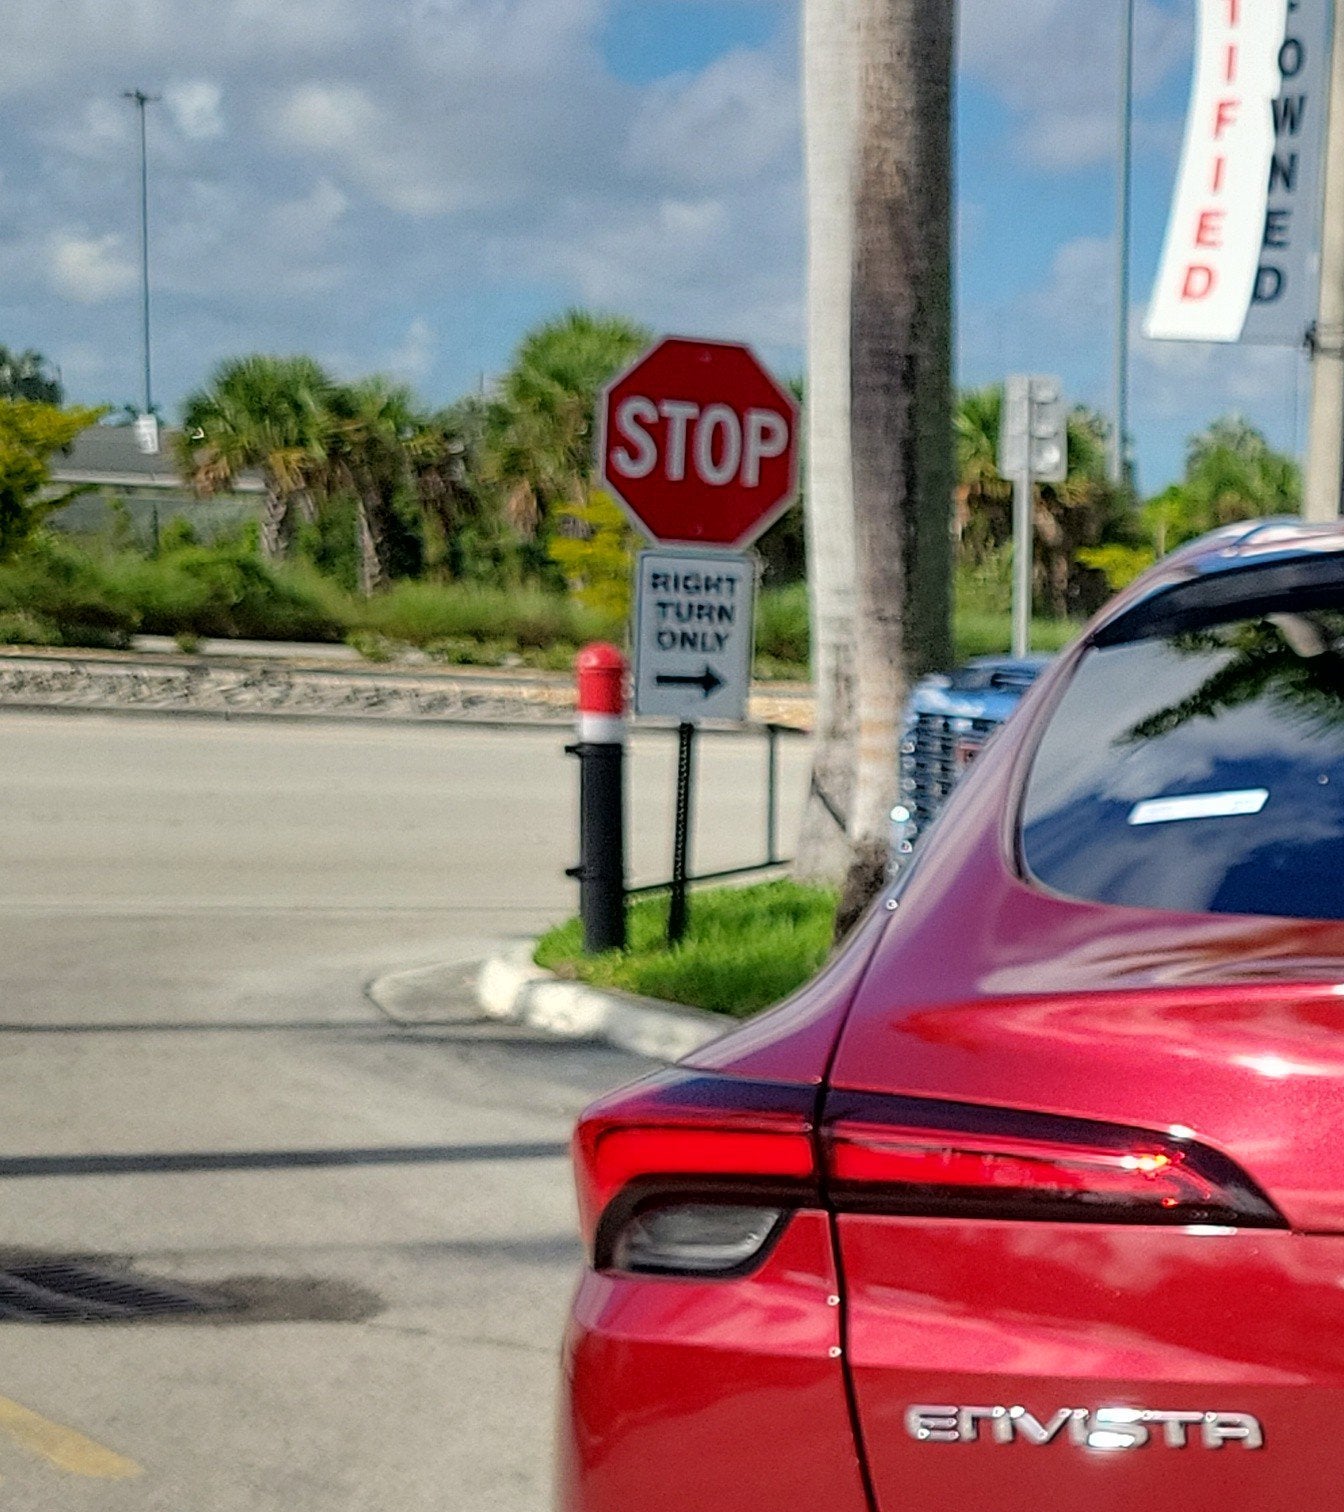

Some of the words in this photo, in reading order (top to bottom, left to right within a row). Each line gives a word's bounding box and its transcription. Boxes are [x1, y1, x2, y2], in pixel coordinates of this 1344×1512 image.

[612, 396, 788, 487] STOP
[652, 573, 739, 596] RIGHT
[657, 602, 734, 624] TURN
[656, 631, 729, 653] ONLY
[904, 1404, 1265, 1450] ENVISTA
